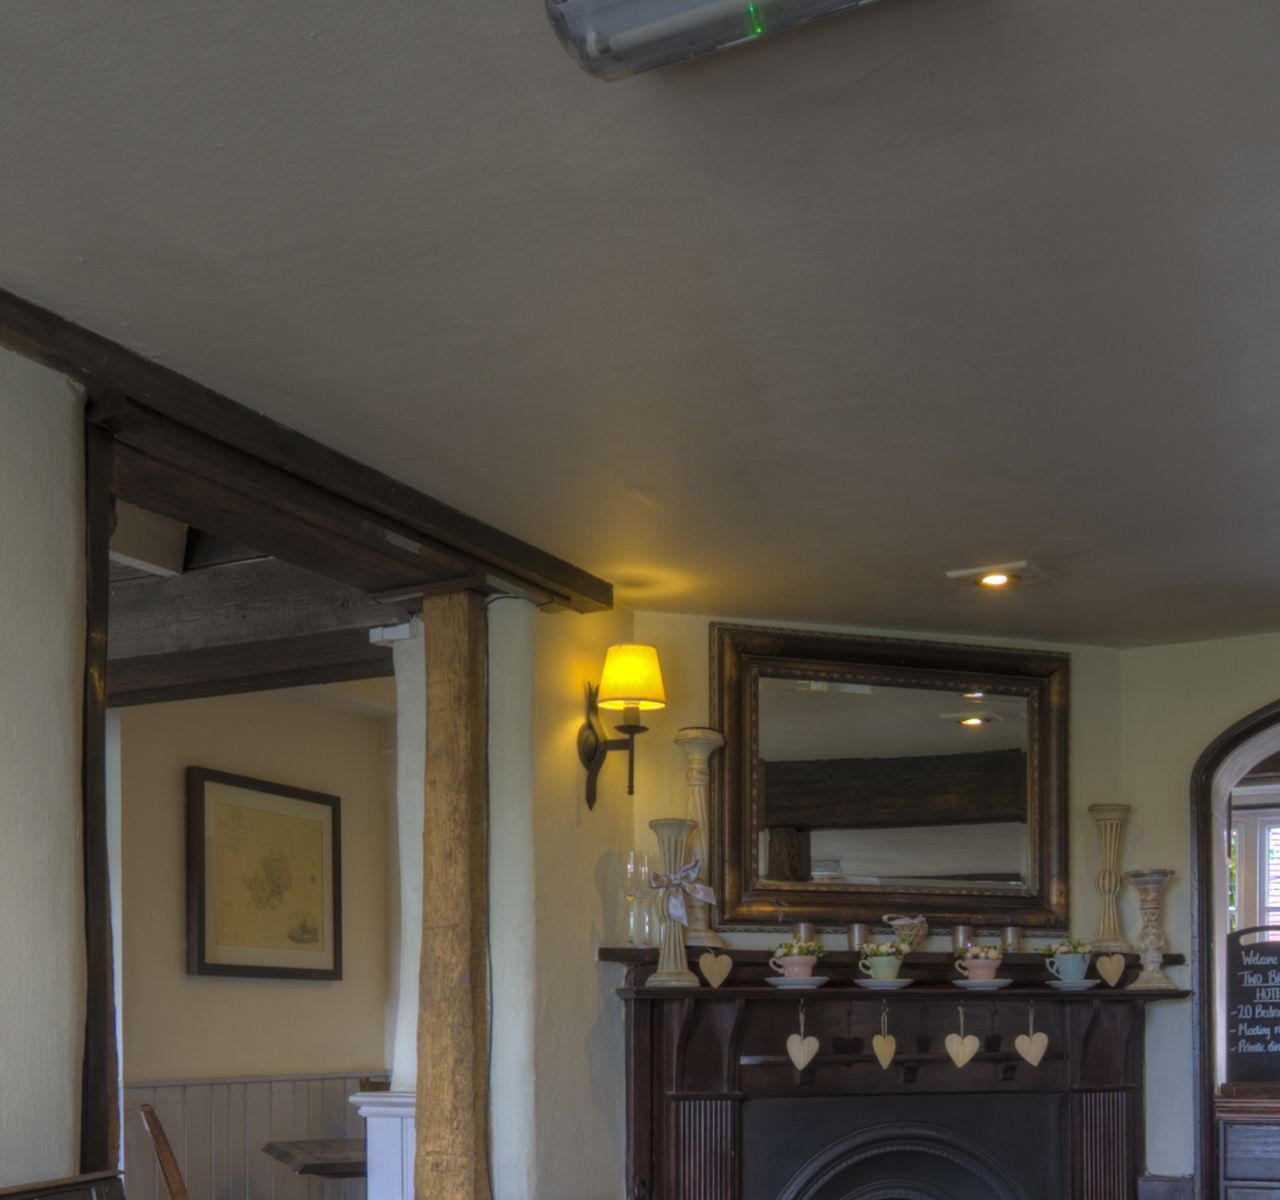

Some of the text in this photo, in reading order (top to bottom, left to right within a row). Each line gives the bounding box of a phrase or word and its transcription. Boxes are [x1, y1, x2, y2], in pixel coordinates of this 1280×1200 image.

[1241, 950, 1278, 966] Welcome
[1238, 969, 1263, 985] TWO
[1238, 1004, 1252, 1019] 20
